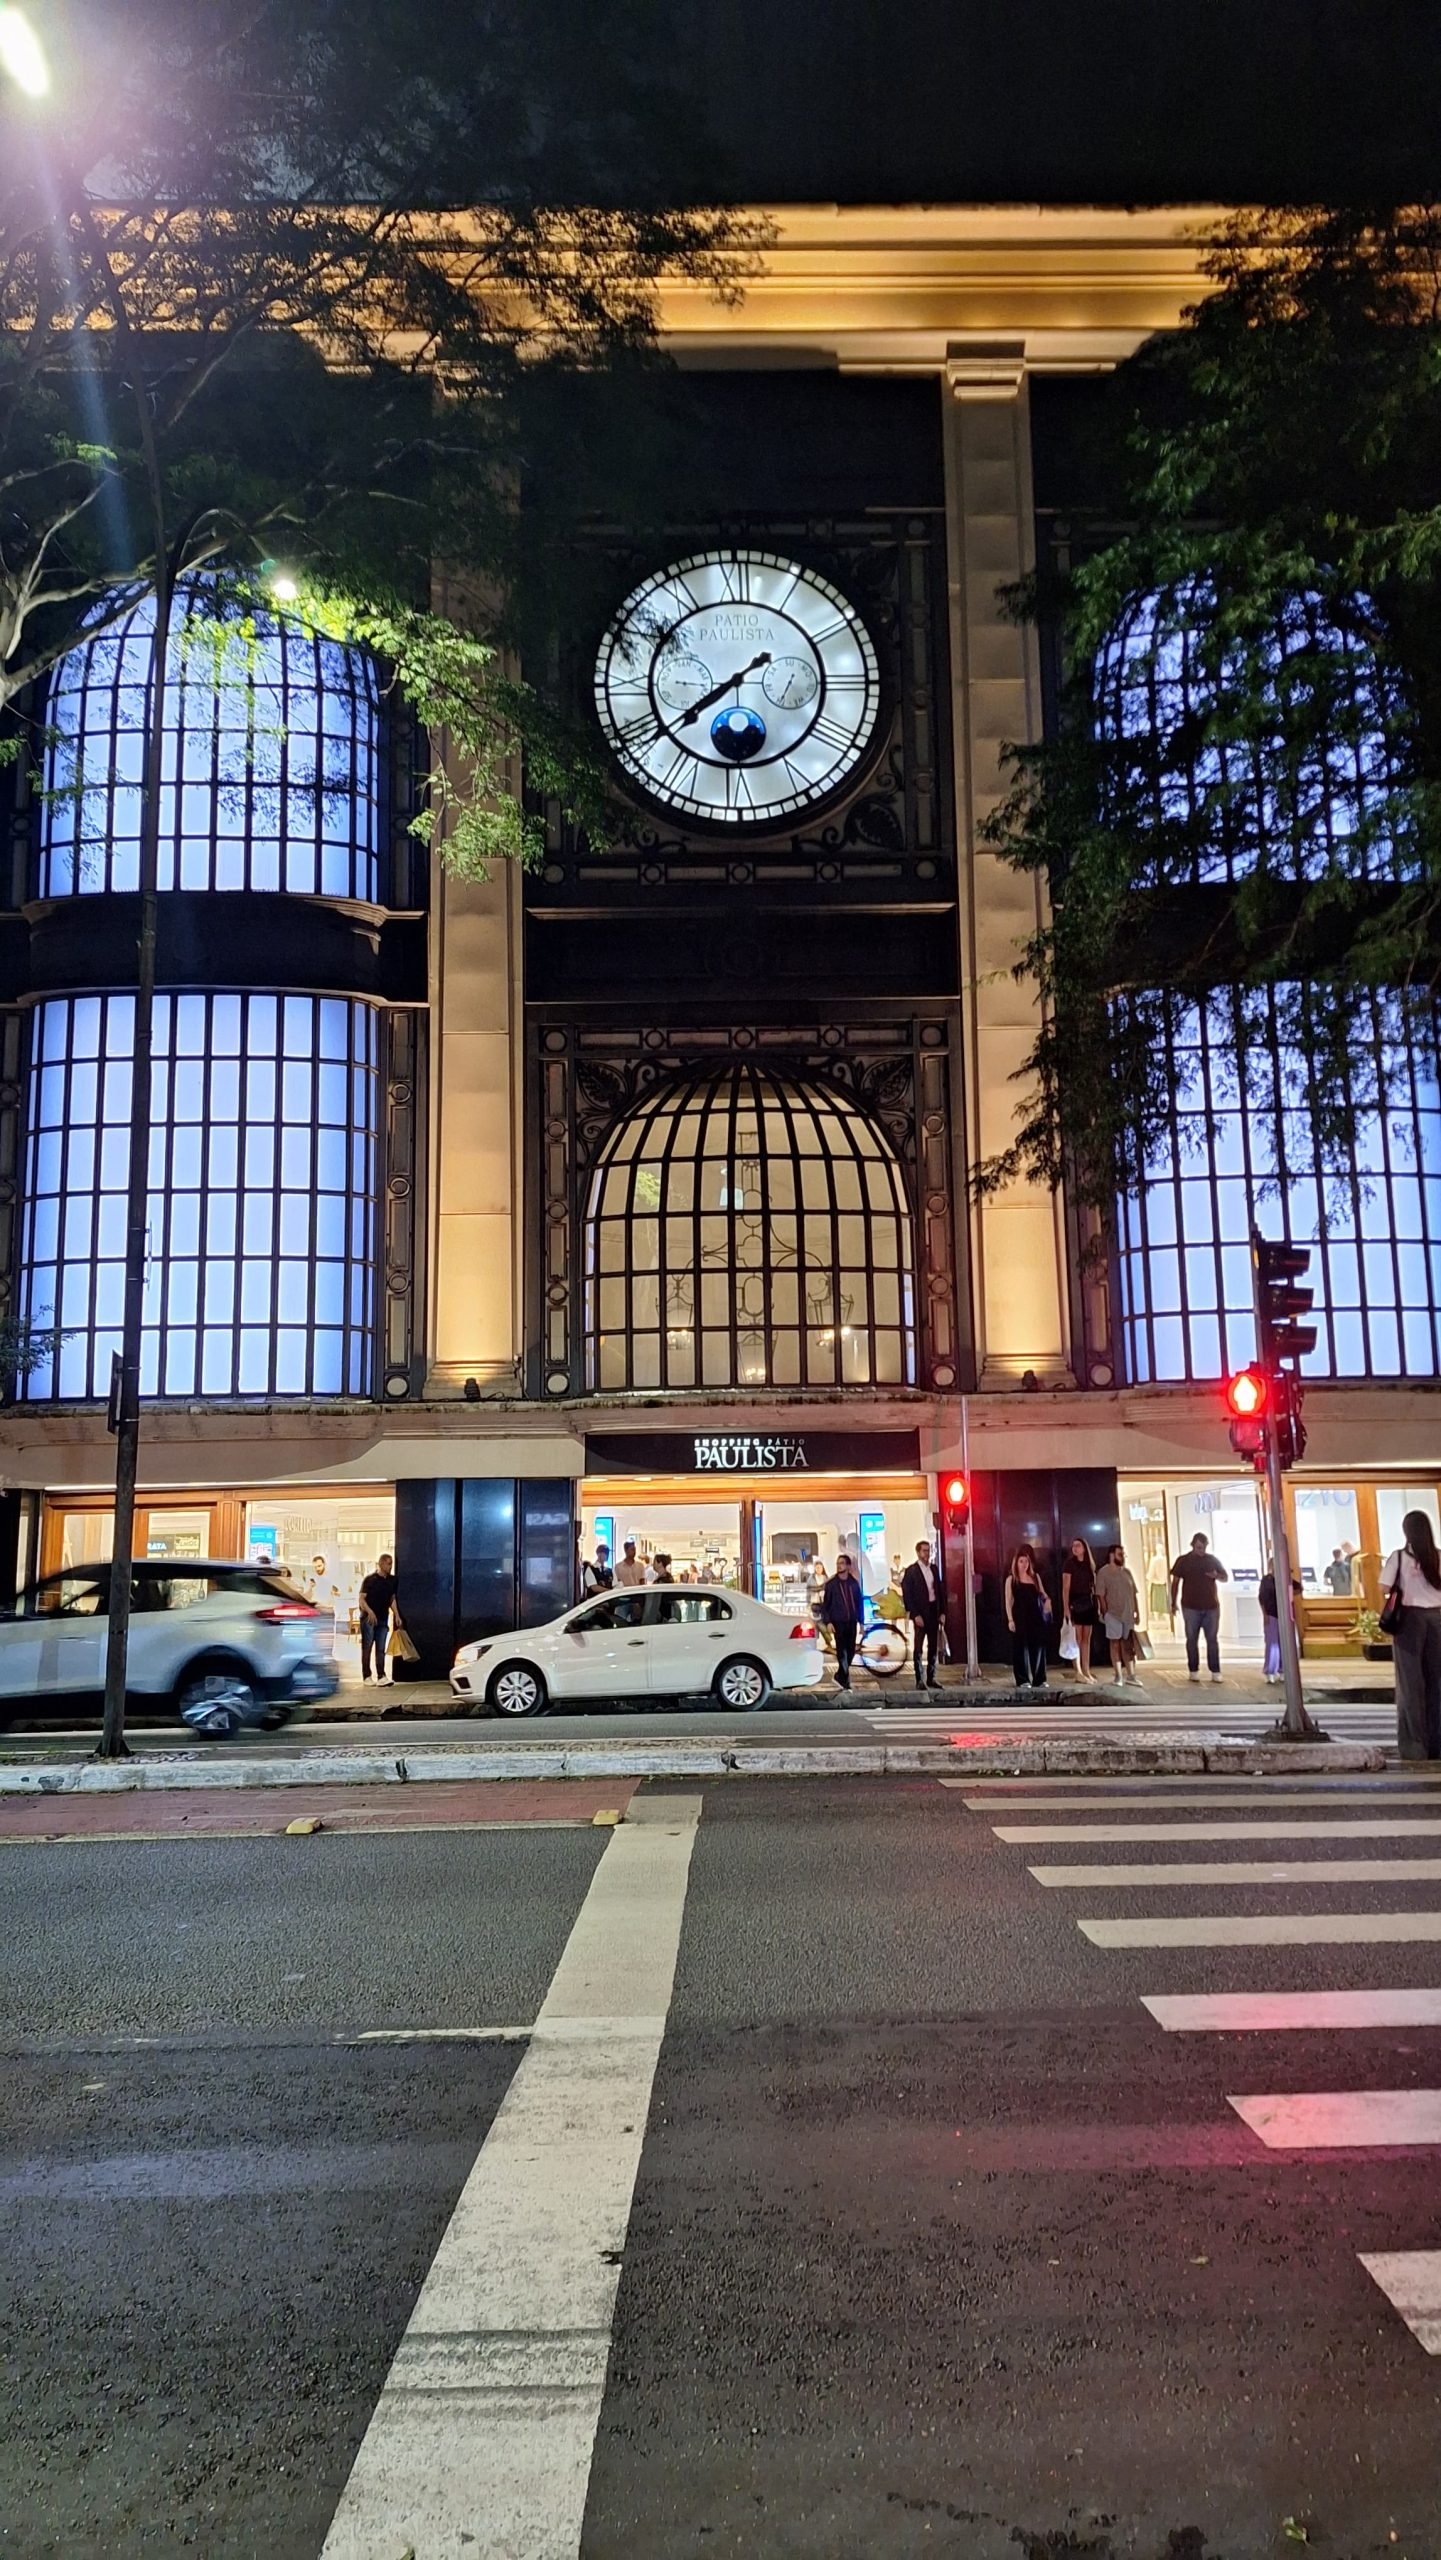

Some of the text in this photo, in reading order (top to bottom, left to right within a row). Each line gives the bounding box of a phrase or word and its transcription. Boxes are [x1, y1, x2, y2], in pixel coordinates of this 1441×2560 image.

[715, 614, 759, 627] PATIO
[700, 628, 775, 641] PAULISTA
[694, 1438, 760, 1446] SHOPPING
[694, 1446, 810, 1469] PAULISTA
